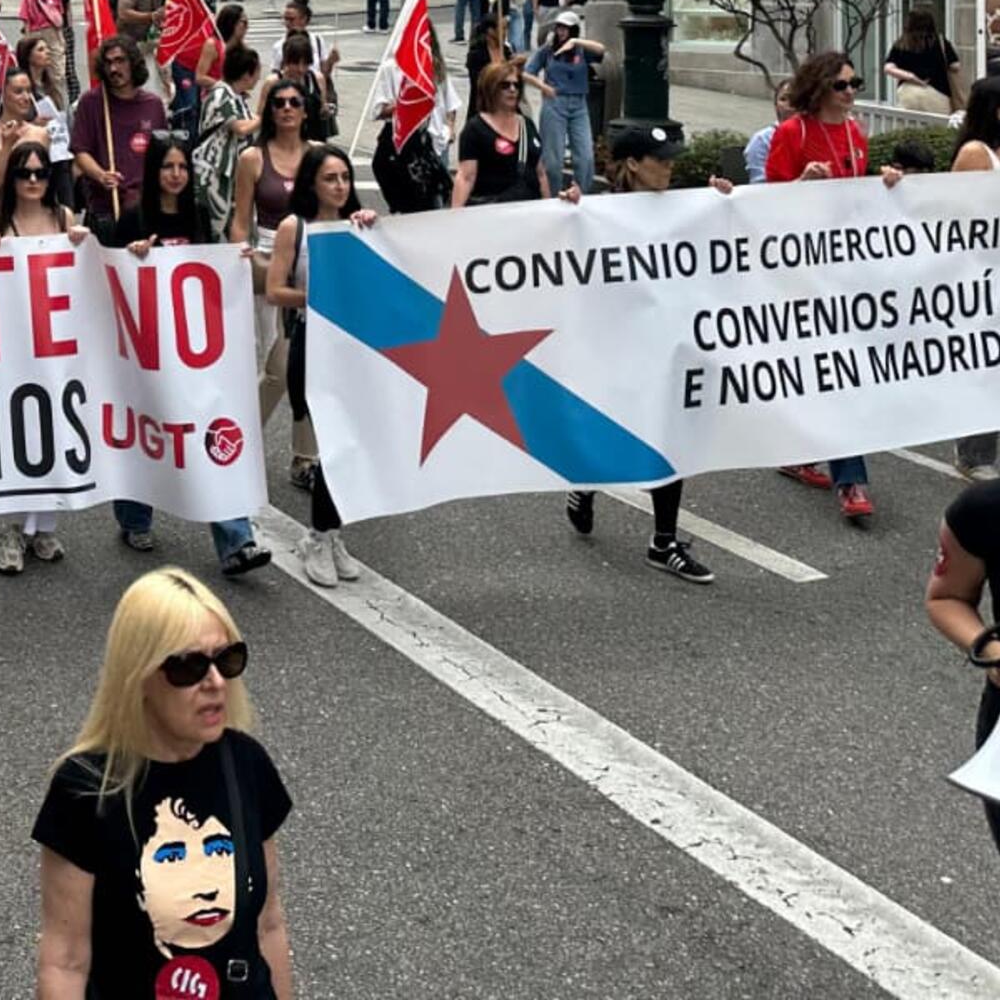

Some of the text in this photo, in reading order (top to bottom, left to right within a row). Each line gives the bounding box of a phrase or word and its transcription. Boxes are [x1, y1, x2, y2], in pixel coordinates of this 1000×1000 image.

[465, 241, 697, 294] CONVENIO
[709, 237, 750, 274] DE
[760, 224, 916, 270] COMERCIO
[106, 262, 225, 370] NO
[693, 268, 993, 352] CONVENIOS AQUÍ
[684, 330, 1000, 409] E NON EN MADRID
[102, 403, 195, 468] UGT
